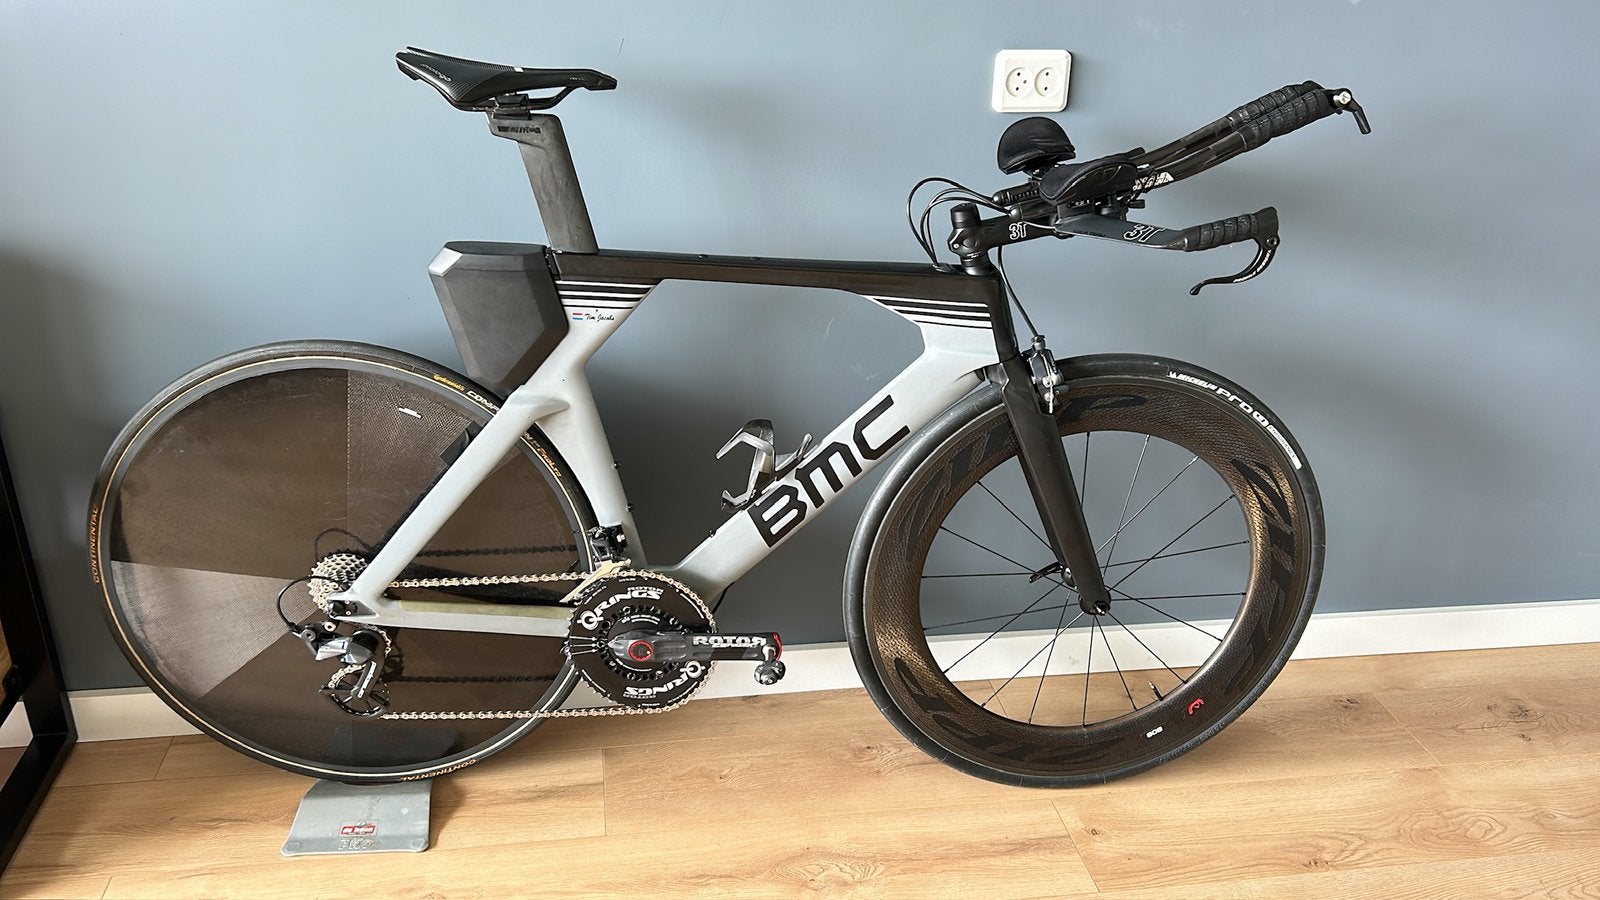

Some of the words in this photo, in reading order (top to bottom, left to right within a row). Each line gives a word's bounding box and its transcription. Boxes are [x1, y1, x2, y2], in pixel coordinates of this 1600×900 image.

[1008, 222, 1028, 240] 3T
[1123, 223, 1167, 243] 3T
[747, 394, 910, 548] BMC
[89, 505, 100, 584] CONTINENTAL
[692, 635, 767, 646] ROTOR
[400, 758, 477, 781] CONTINENTAL
